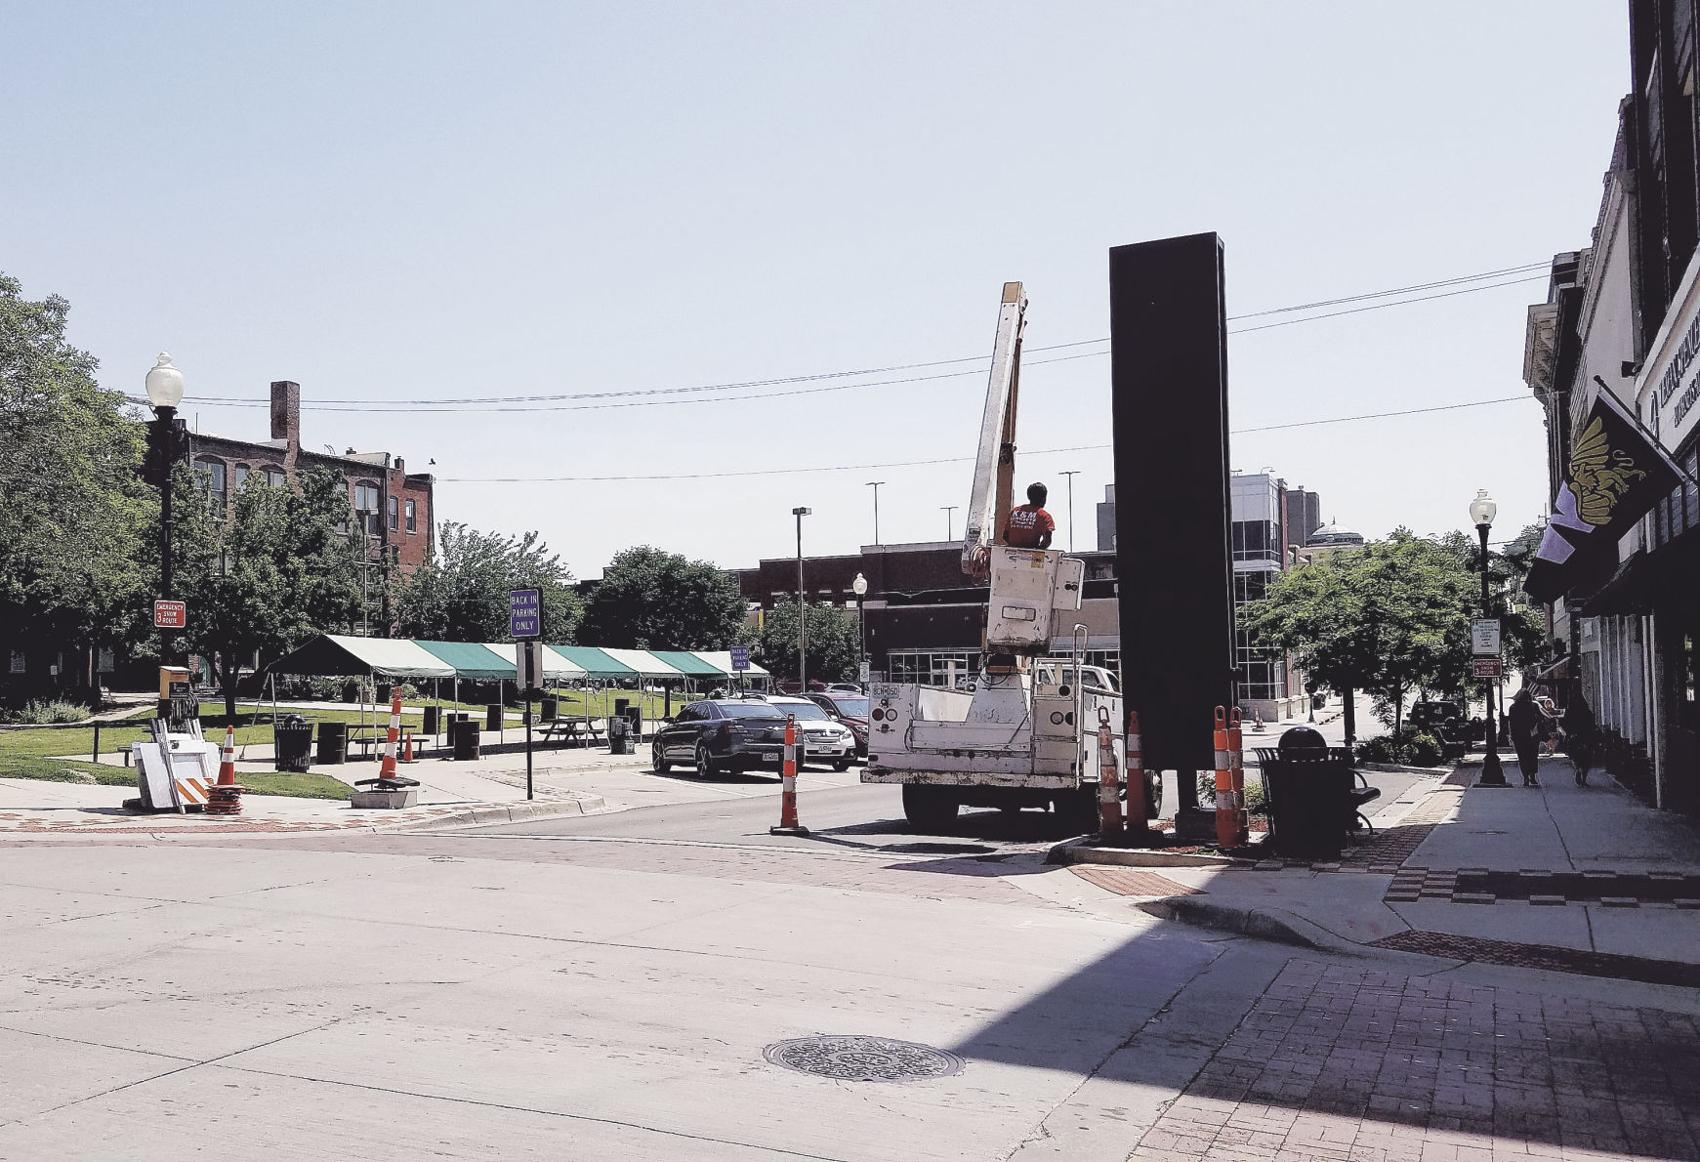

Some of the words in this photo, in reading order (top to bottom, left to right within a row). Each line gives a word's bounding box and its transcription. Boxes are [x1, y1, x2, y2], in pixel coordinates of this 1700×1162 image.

[511, 596, 528, 605] BACK
[530, 595, 537, 604] IN
[156, 603, 183, 611] EMERGENCY
[512, 608, 537, 617] PARKING
[156, 612, 162, 623] 3
[516, 621, 534, 630] ONLY
